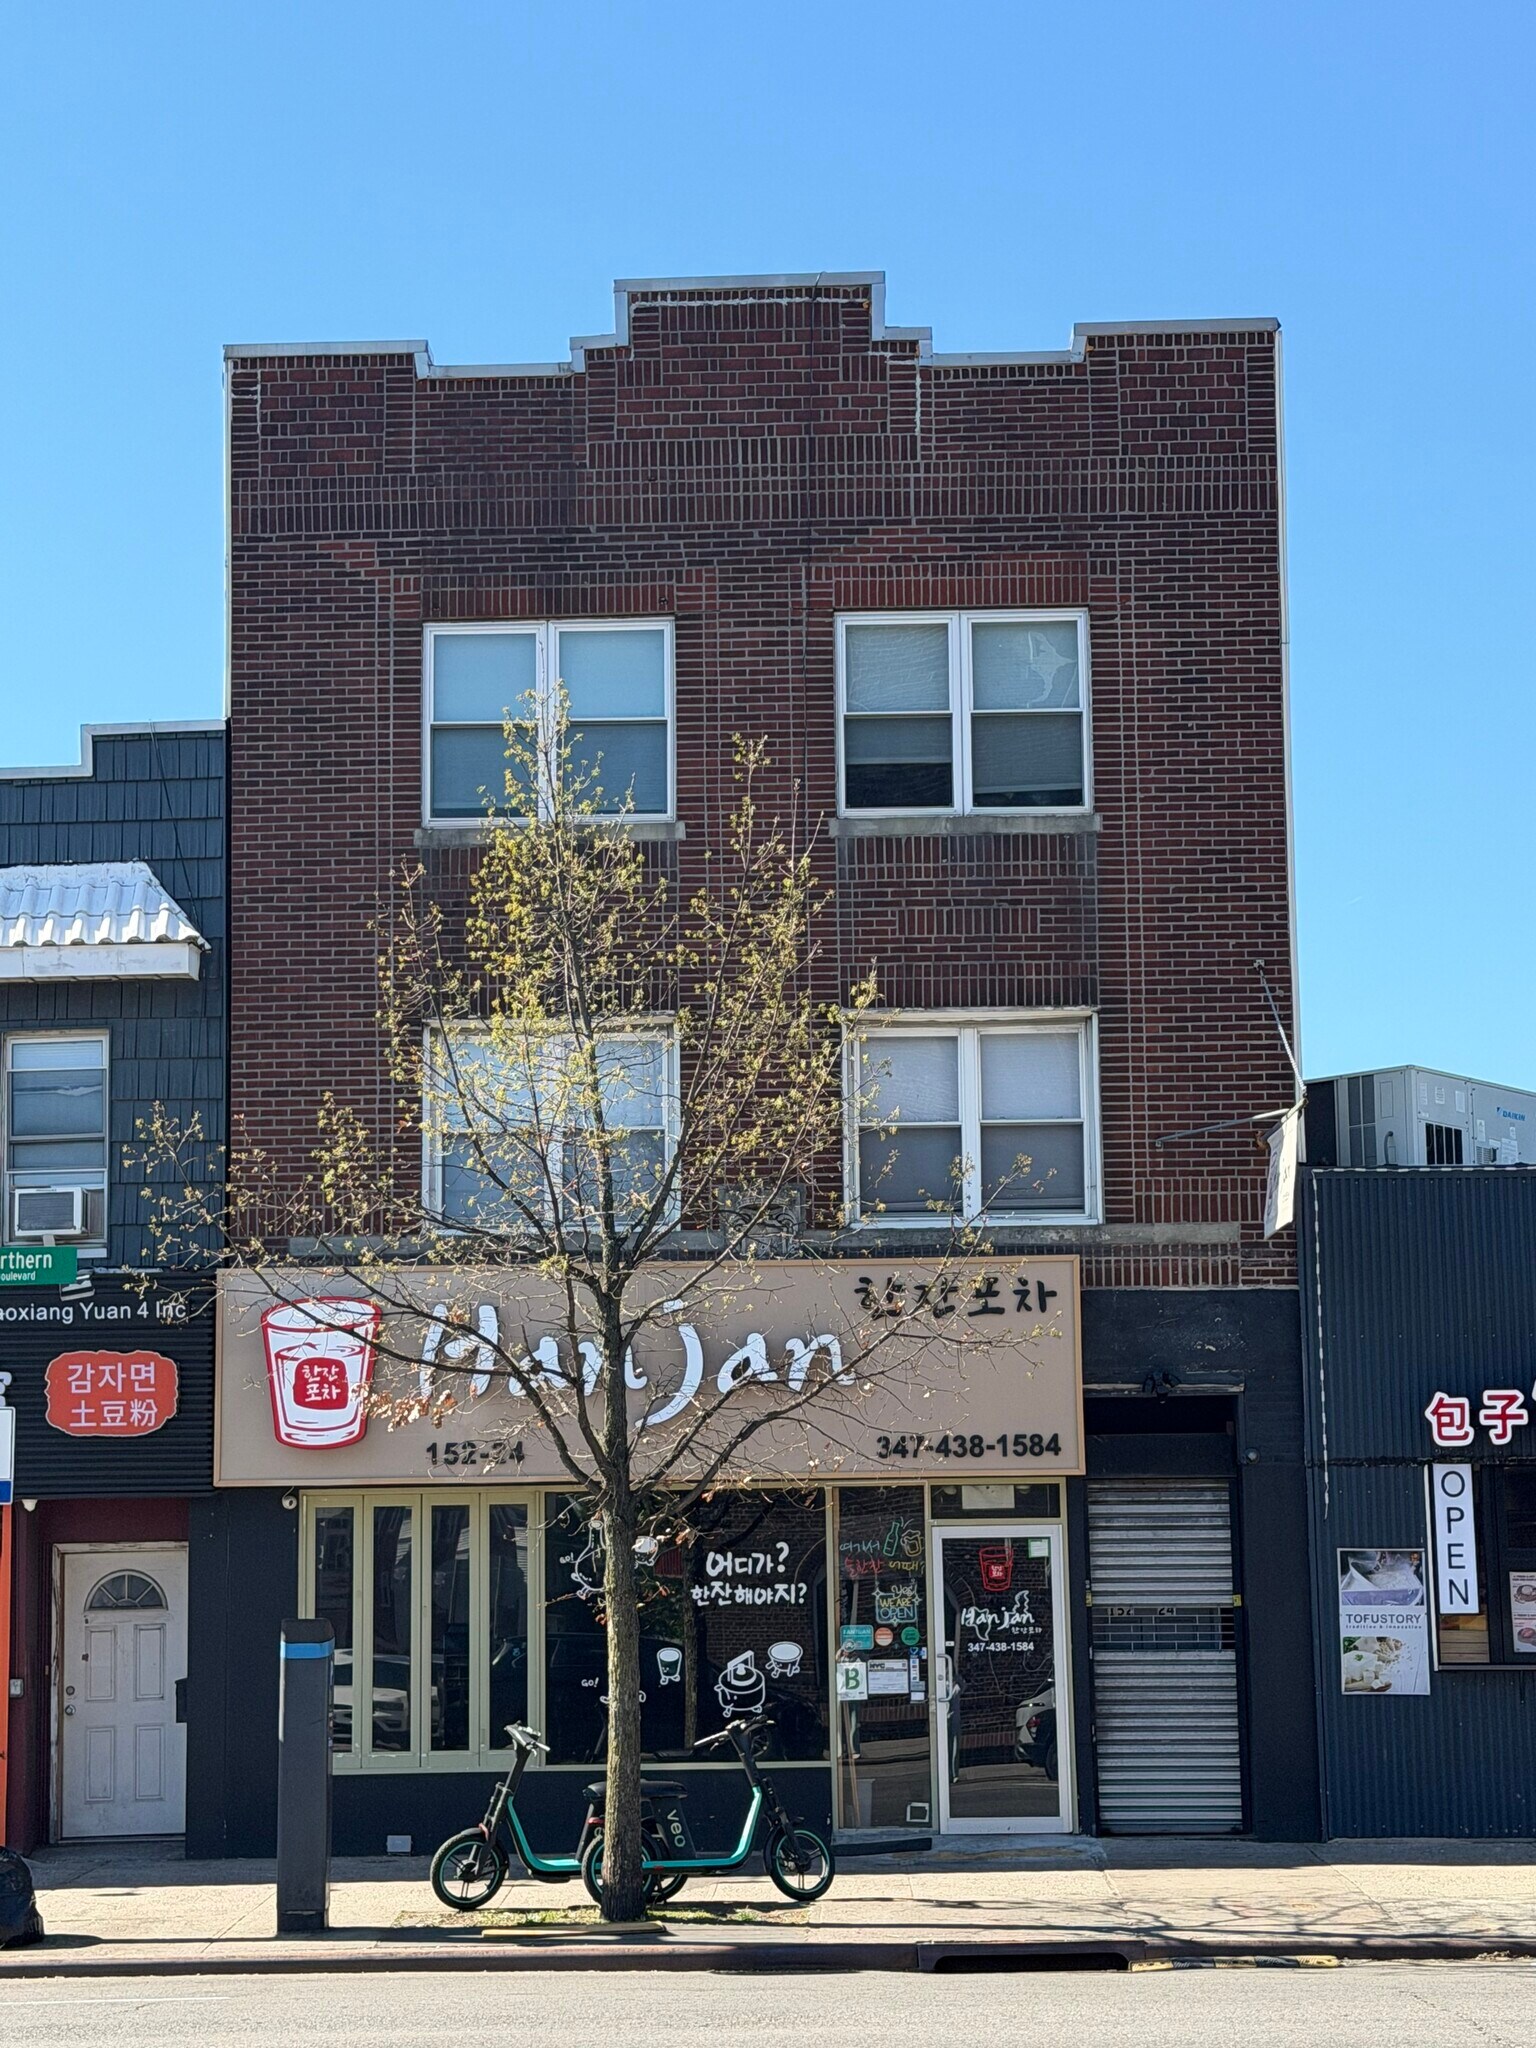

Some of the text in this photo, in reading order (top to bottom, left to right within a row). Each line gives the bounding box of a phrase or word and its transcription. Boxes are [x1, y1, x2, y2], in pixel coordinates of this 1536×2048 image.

[1502, 1111, 1526, 1121] DAIKIN
[0, 1251, 53, 1270] rthern
[79, 1301, 132, 1320] Yuan
[136, 1302, 150, 1319] 4
[155, 1301, 187, 1319] Inc
[67, 1361, 156, 1394] 감자면
[300, 1363, 340, 1383] 한잔
[304, 1384, 342, 1402] 포차
[69, 1398, 158, 1428] 土豆粉
[1427, 1391, 1527, 1445] 包子
[426, 1440, 525, 1465] 152-24
[876, 1433, 1063, 1459] 347-438-1584
[1440, 1469, 1470, 1606] OPEN
[559, 1552, 575, 1564] GO!
[705, 1541, 790, 1577] 어디가?
[690, 1580, 808, 1607] 한잔해야지?
[880, 1597, 913, 1607] WE ARE
[880, 1607, 913, 1619] OPEN
[1346, 1613, 1422, 1625] TOFUSTORY
[967, 1641, 1035, 1652] 347-438-1584
[581, 1677, 599, 1687] GO!
[844, 1667, 860, 1690] B
[667, 1809, 686, 1847] veo
